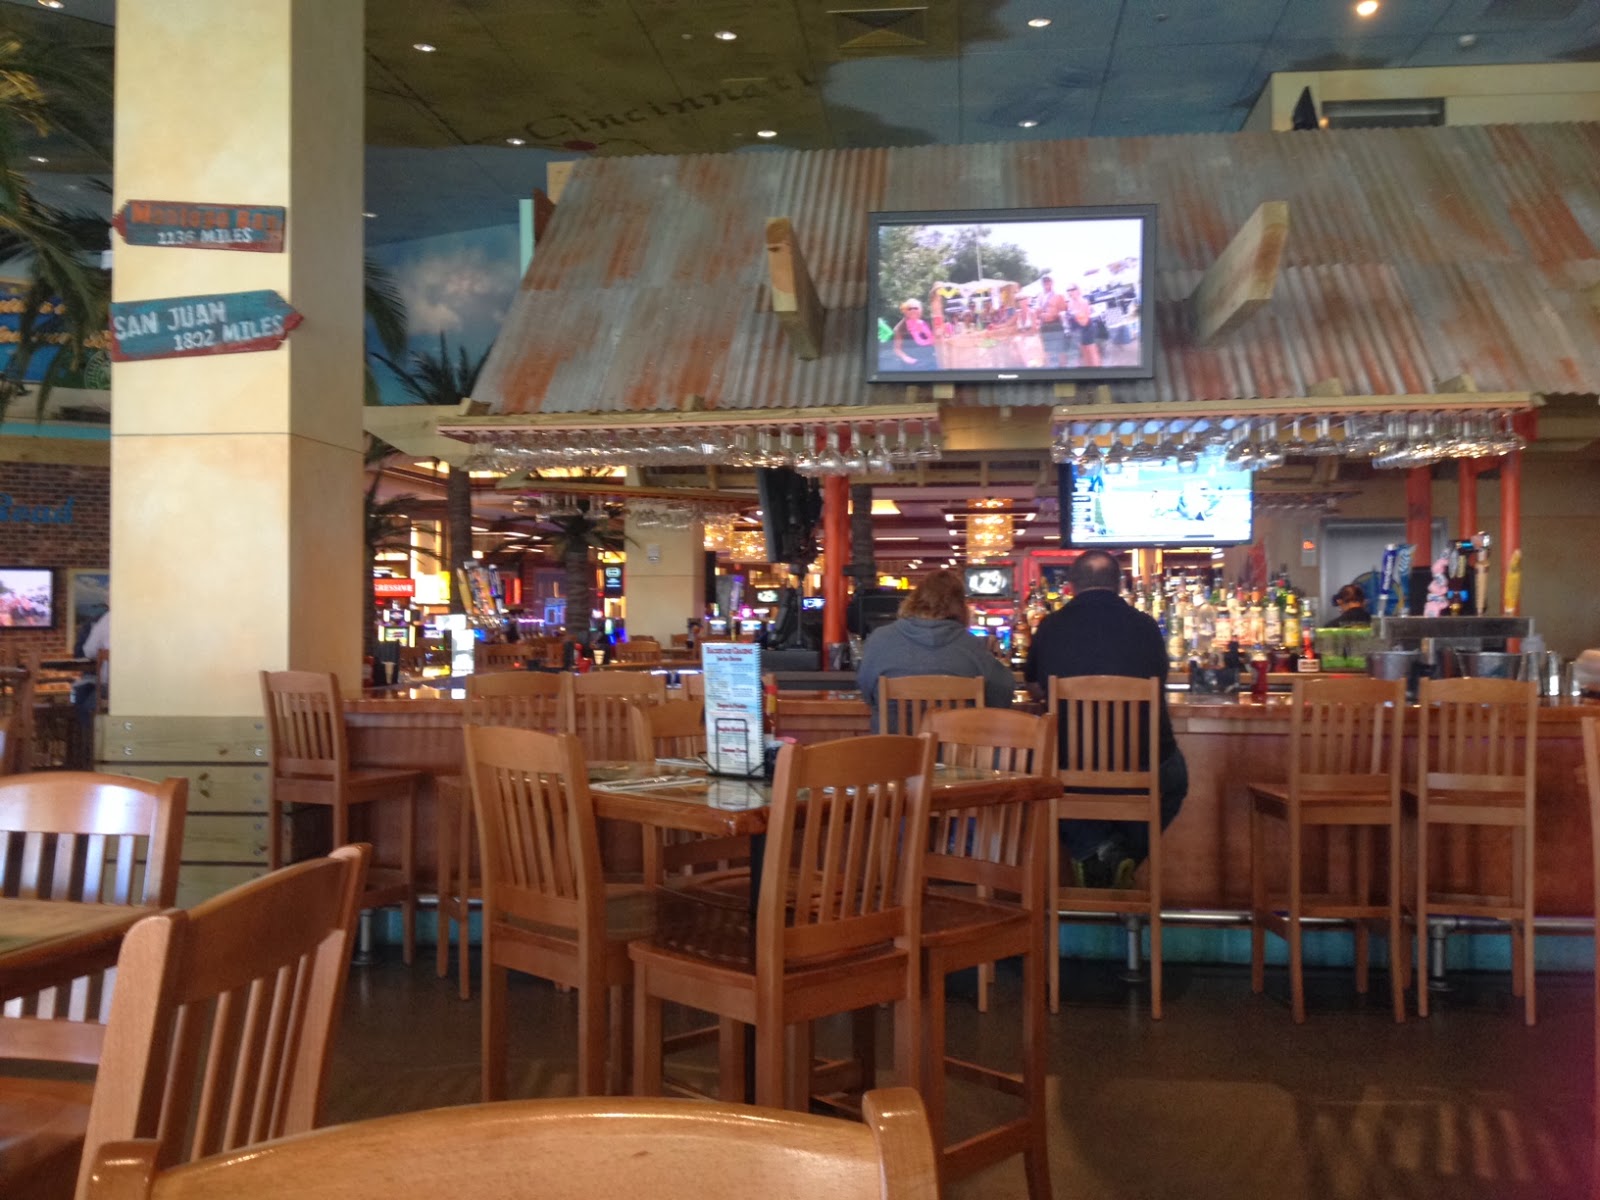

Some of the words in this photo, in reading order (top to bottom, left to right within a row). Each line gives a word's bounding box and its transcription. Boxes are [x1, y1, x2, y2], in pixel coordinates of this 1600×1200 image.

[201, 227, 253, 243] MILES
[113, 311, 158, 340] SAN
[167, 301, 226, 331] JUAN
[222, 315, 284, 342] MILES
